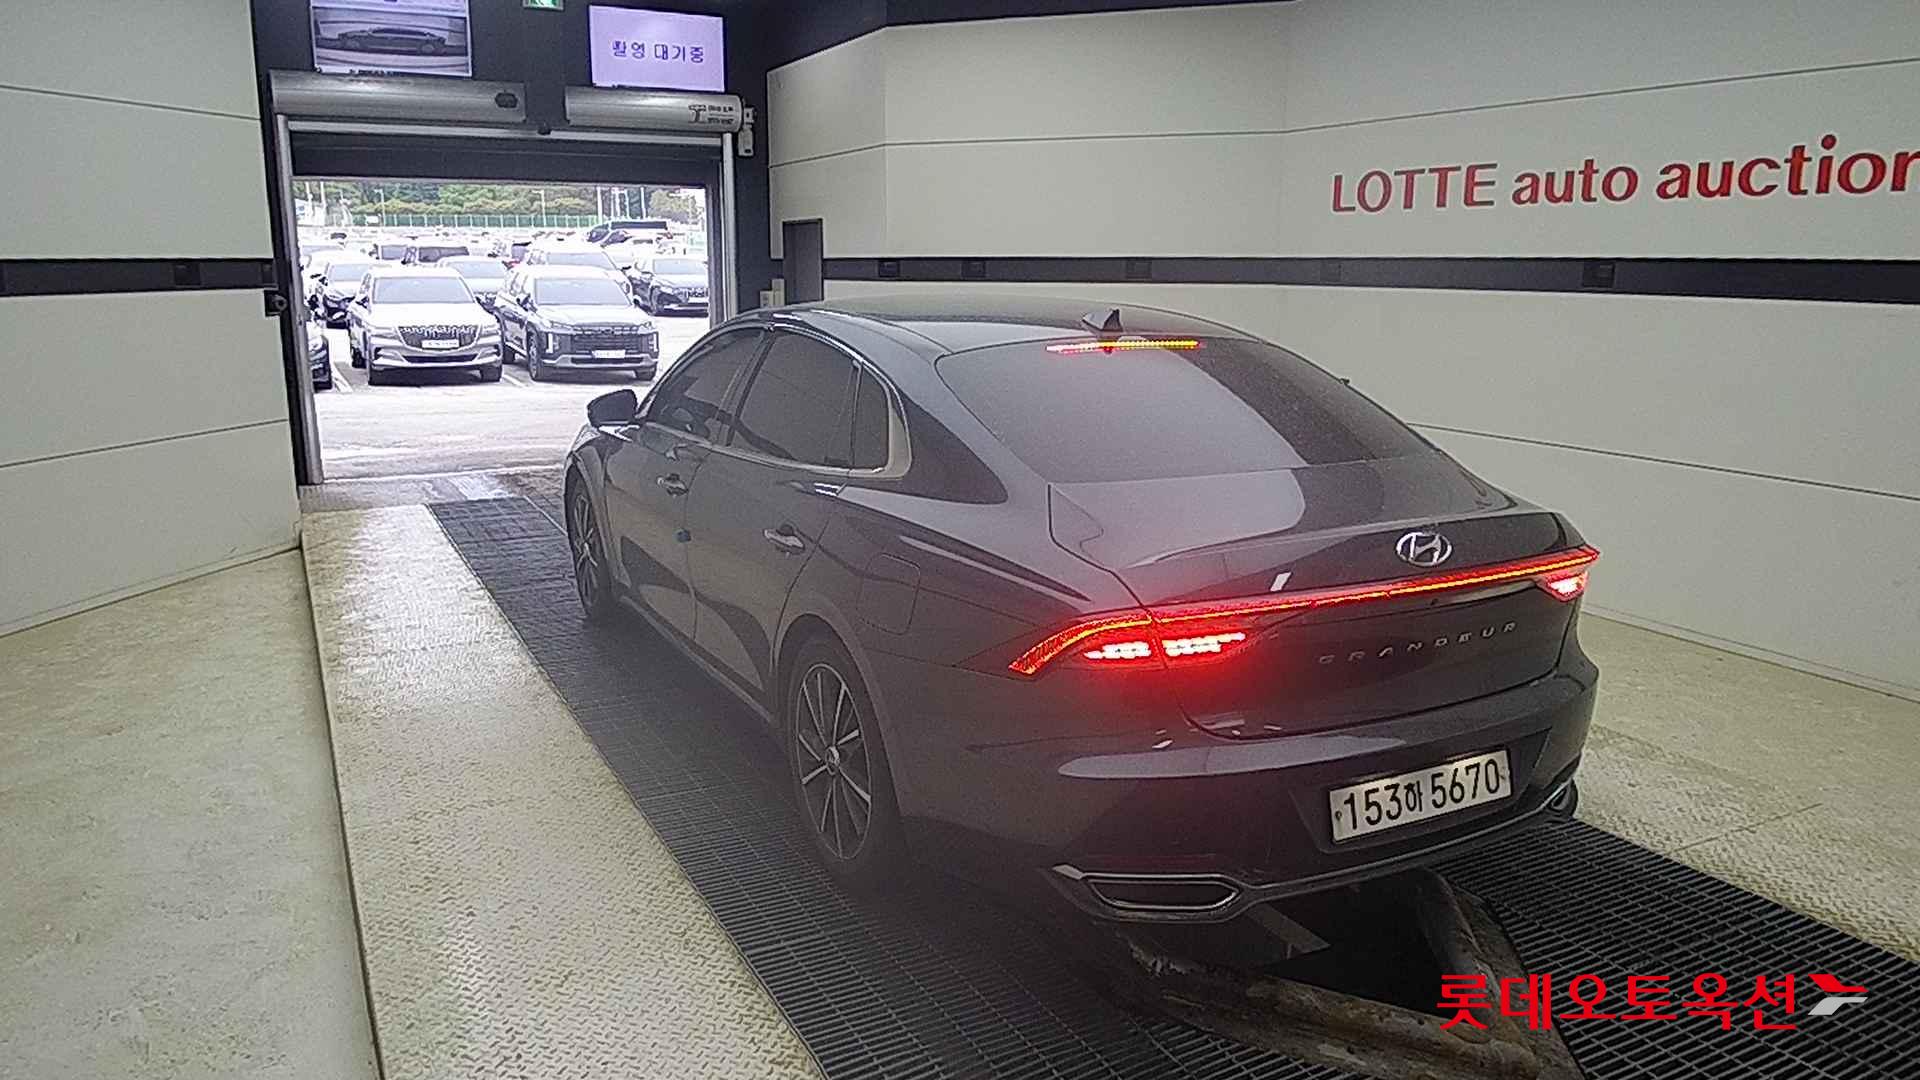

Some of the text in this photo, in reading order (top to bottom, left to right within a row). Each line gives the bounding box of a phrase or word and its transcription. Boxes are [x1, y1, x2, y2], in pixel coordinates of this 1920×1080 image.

[654, 44, 704, 63] 대기중
[1332, 163, 1498, 212] LOTTE
[1512, 158, 1638, 205] auto
[1319, 621, 1516, 664] GRANDEUR
